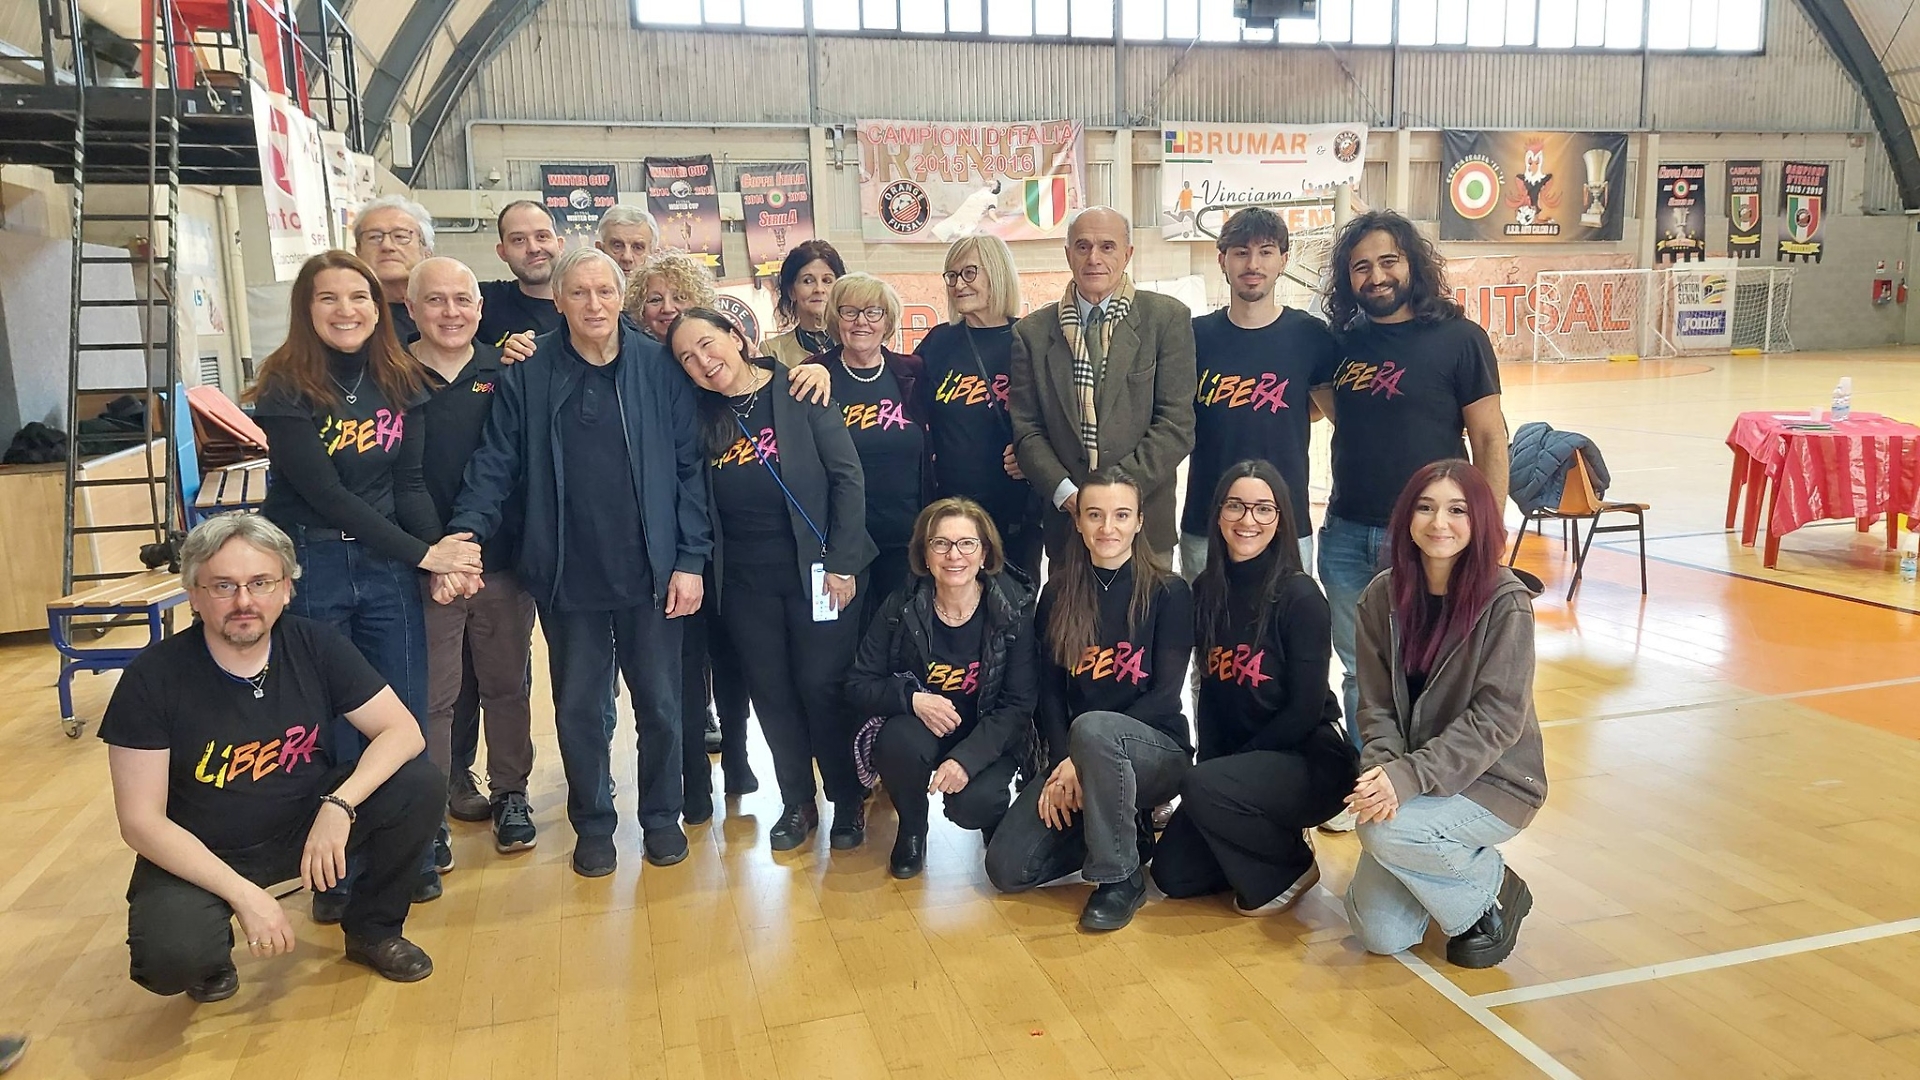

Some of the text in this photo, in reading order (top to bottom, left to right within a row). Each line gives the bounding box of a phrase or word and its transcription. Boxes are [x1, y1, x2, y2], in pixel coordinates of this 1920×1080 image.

[866, 124, 1076, 147] CAMPIONI D'ITALIA
[1187, 131, 1308, 155] BRUMAR
[649, 164, 709, 178] WINTER CUP
[913, 154, 966, 174] 2015
[982, 153, 1035, 174] 2016
[547, 174, 610, 186] WINTER CUP
[884, 183, 925, 201] ORANGE
[1201, 179, 1292, 206] Vinciamo
[786, 208, 798, 224] A
[888, 218, 923, 232] FUTSAL
[1454, 281, 1631, 337] UTSAL
[1677, 293, 1700, 305] SENNA
[1070, 642, 1149, 686] BERA
[1207, 643, 1274, 688] BERA
